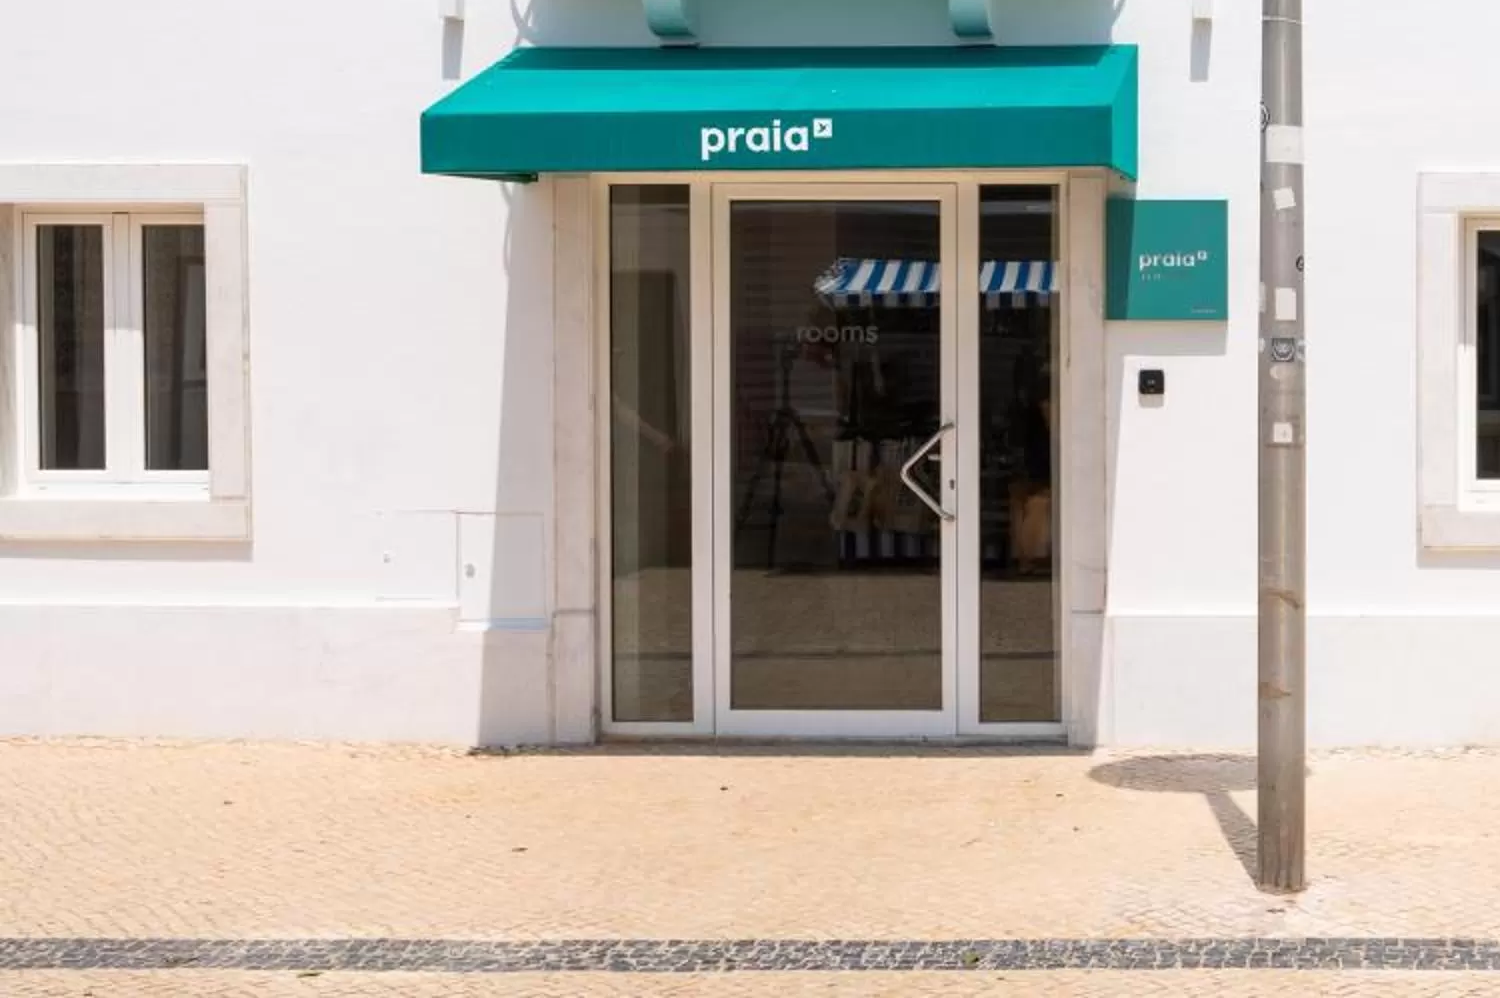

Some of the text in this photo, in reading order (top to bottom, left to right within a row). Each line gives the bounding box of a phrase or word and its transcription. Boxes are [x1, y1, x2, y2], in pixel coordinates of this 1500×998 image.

[701, 118, 809, 161] praia
[1138, 251, 1196, 271] praia
[796, 325, 879, 343] rooms
